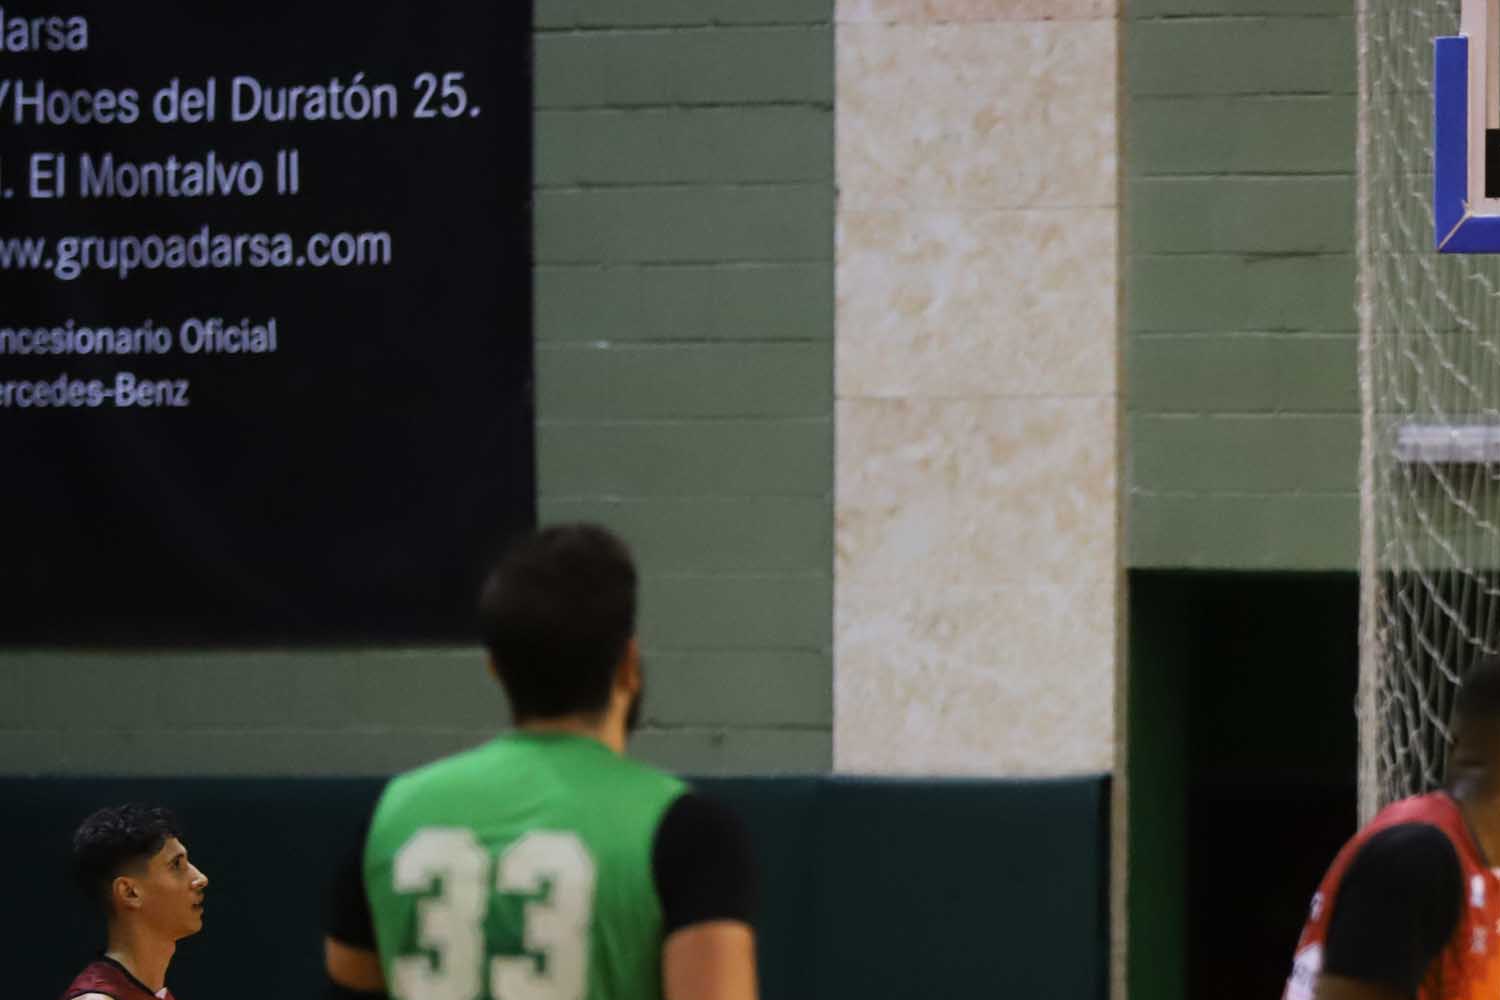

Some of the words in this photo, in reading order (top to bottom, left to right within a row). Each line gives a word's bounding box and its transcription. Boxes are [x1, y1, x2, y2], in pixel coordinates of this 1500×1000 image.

[152, 76, 216, 123] del
[231, 72, 398, 122] Duratón
[413, 72, 482, 120] 25.
[30, 152, 65, 198] El
[80, 150, 264, 198] Montalvo
[179, 318, 277, 353] Oficial
